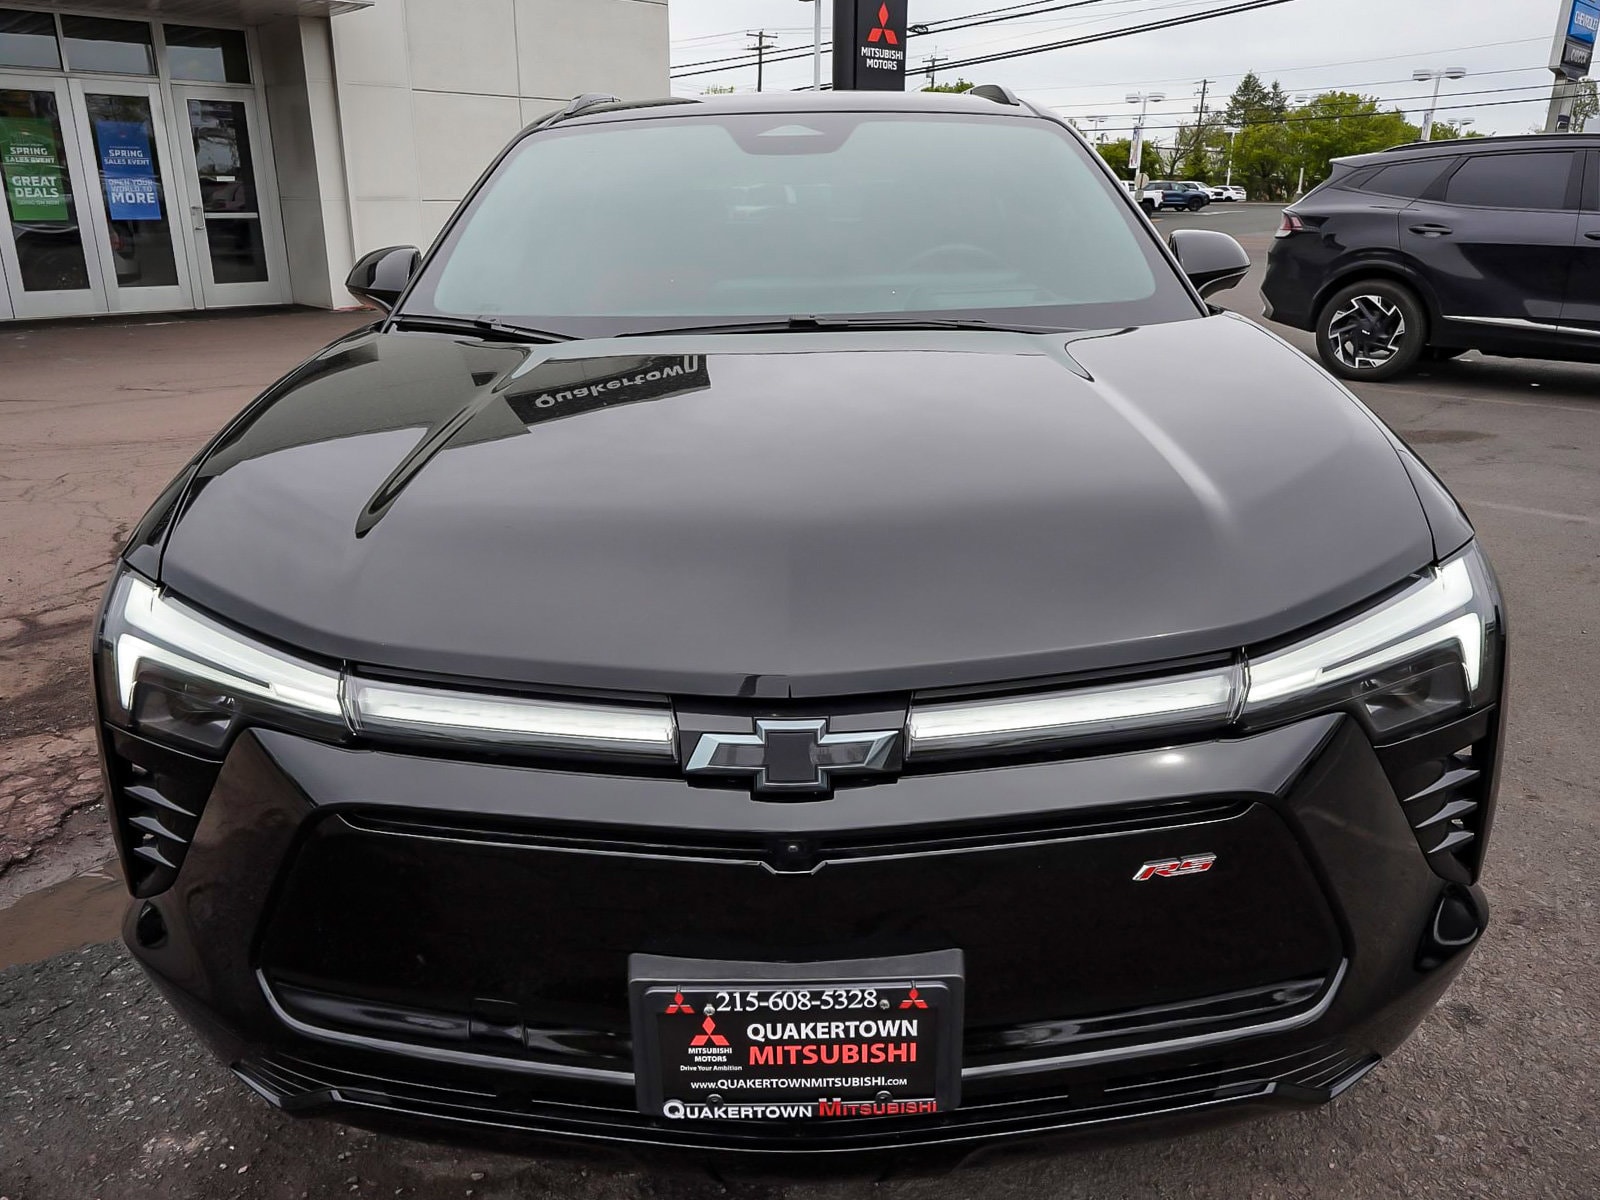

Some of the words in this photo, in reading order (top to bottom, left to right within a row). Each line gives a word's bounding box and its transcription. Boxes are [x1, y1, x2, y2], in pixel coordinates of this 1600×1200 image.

[861, 46, 904, 60] MITSUBISHI
[866, 58, 898, 71] MOTORS
[9, 147, 48, 156] SPRING
[108, 149, 144, 158] SPRING
[5, 156, 29, 164] SALES
[11, 175, 57, 187] GREAT
[108, 178, 130, 186] OPEN
[15, 187, 60, 198] DEALS
[111, 192, 156, 204] MORE
[1132, 852, 1217, 881] RS
[715, 990, 878, 1013] 215-608-5328
[746, 1019, 918, 1043] QUAKERTOWN
[749, 1042, 917, 1066] MITSUBISHI
[663, 1099, 812, 1120] QUAKERTOWN
[818, 1097, 938, 1118] MITSUBISHI
